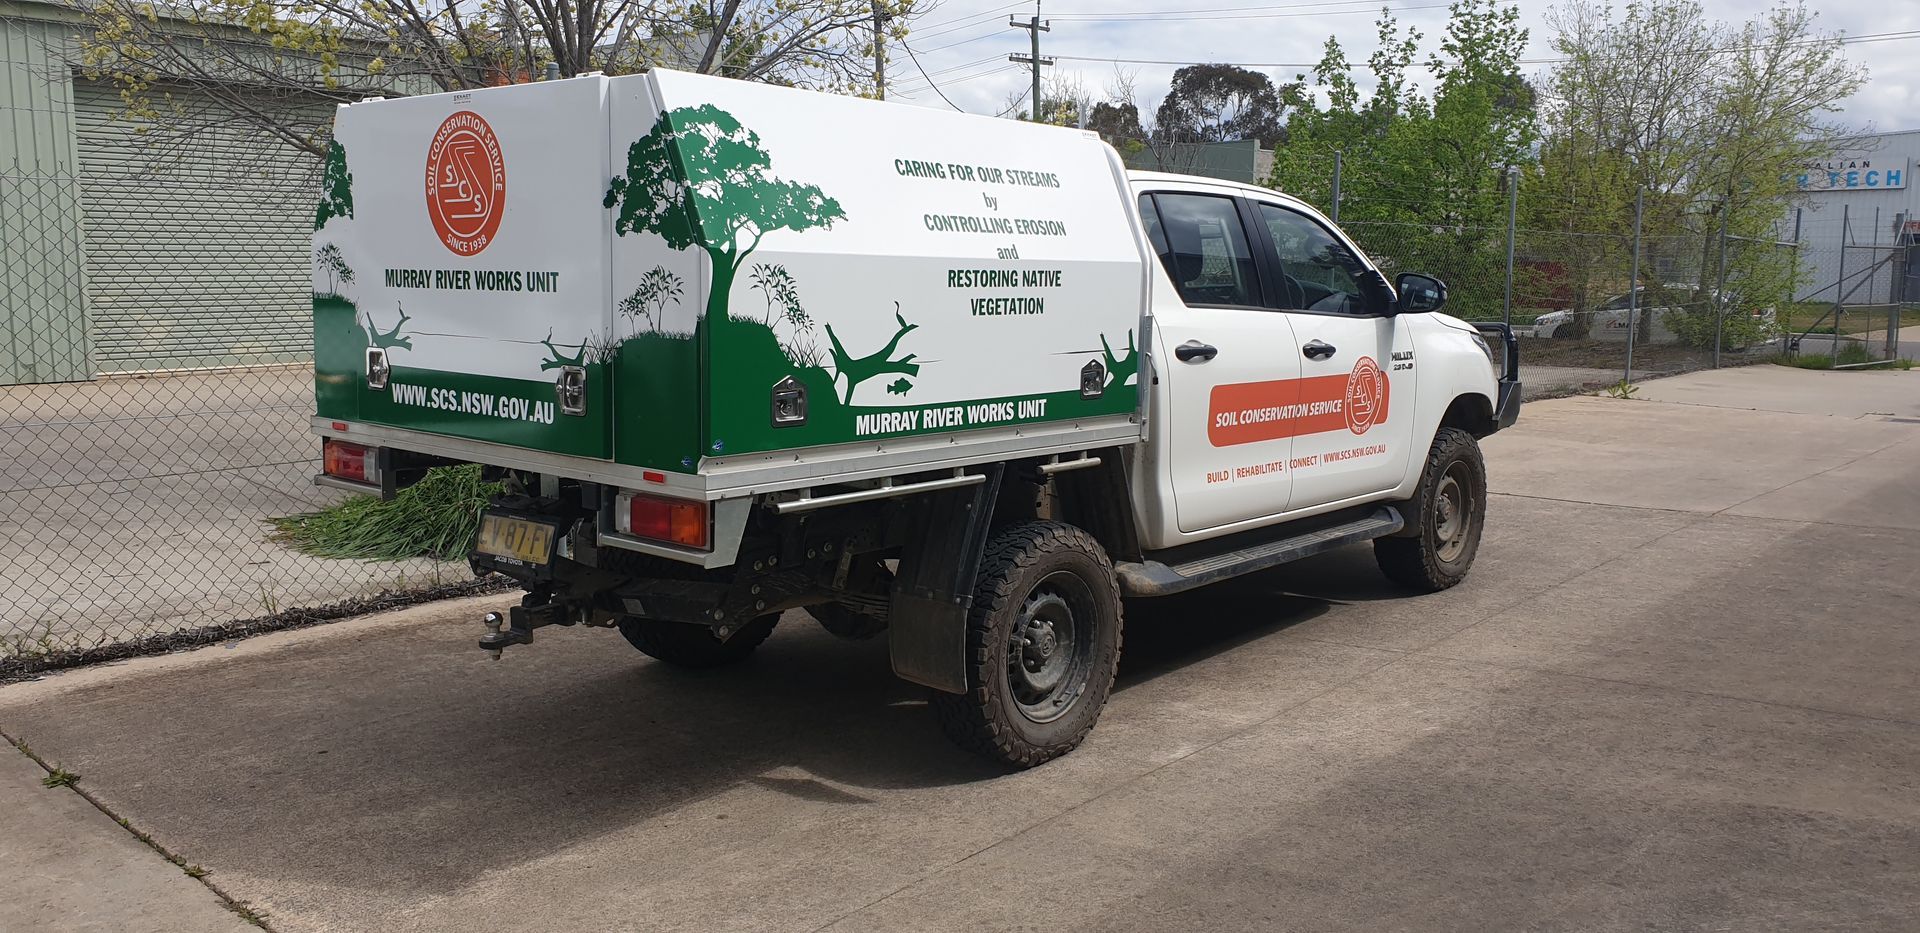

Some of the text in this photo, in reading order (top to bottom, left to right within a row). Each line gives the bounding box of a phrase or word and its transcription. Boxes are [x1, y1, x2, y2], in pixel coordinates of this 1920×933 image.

[428, 115, 503, 196] SOIL CONSERVATION SERVICE
[894, 158, 1060, 189] CARING FOR OUR STREAMS
[1828, 170, 1901, 187] TECH
[983, 192, 998, 211] by
[923, 214, 1067, 237] CONTROLLING EROSION
[446, 233, 487, 252] SINCE 1938
[997, 244, 1019, 260] and
[385, 268, 560, 293] MURRAY RIVER WORKS UNIT
[948, 269, 1062, 288] RESTORING NATIVE
[971, 297, 1044, 316] VEGETATION
[391, 382, 554, 425] WWW.SCS.NSW.GOV.AU
[1215, 399, 1343, 428] SOIL CONSERVATION SERVICE
[856, 399, 1047, 436] MURRAY RIVER WORKS UNIT
[1207, 444, 1386, 484] BUILD REHABILITATE CONNECT WWW.SCS.NSW.GOV.AU
